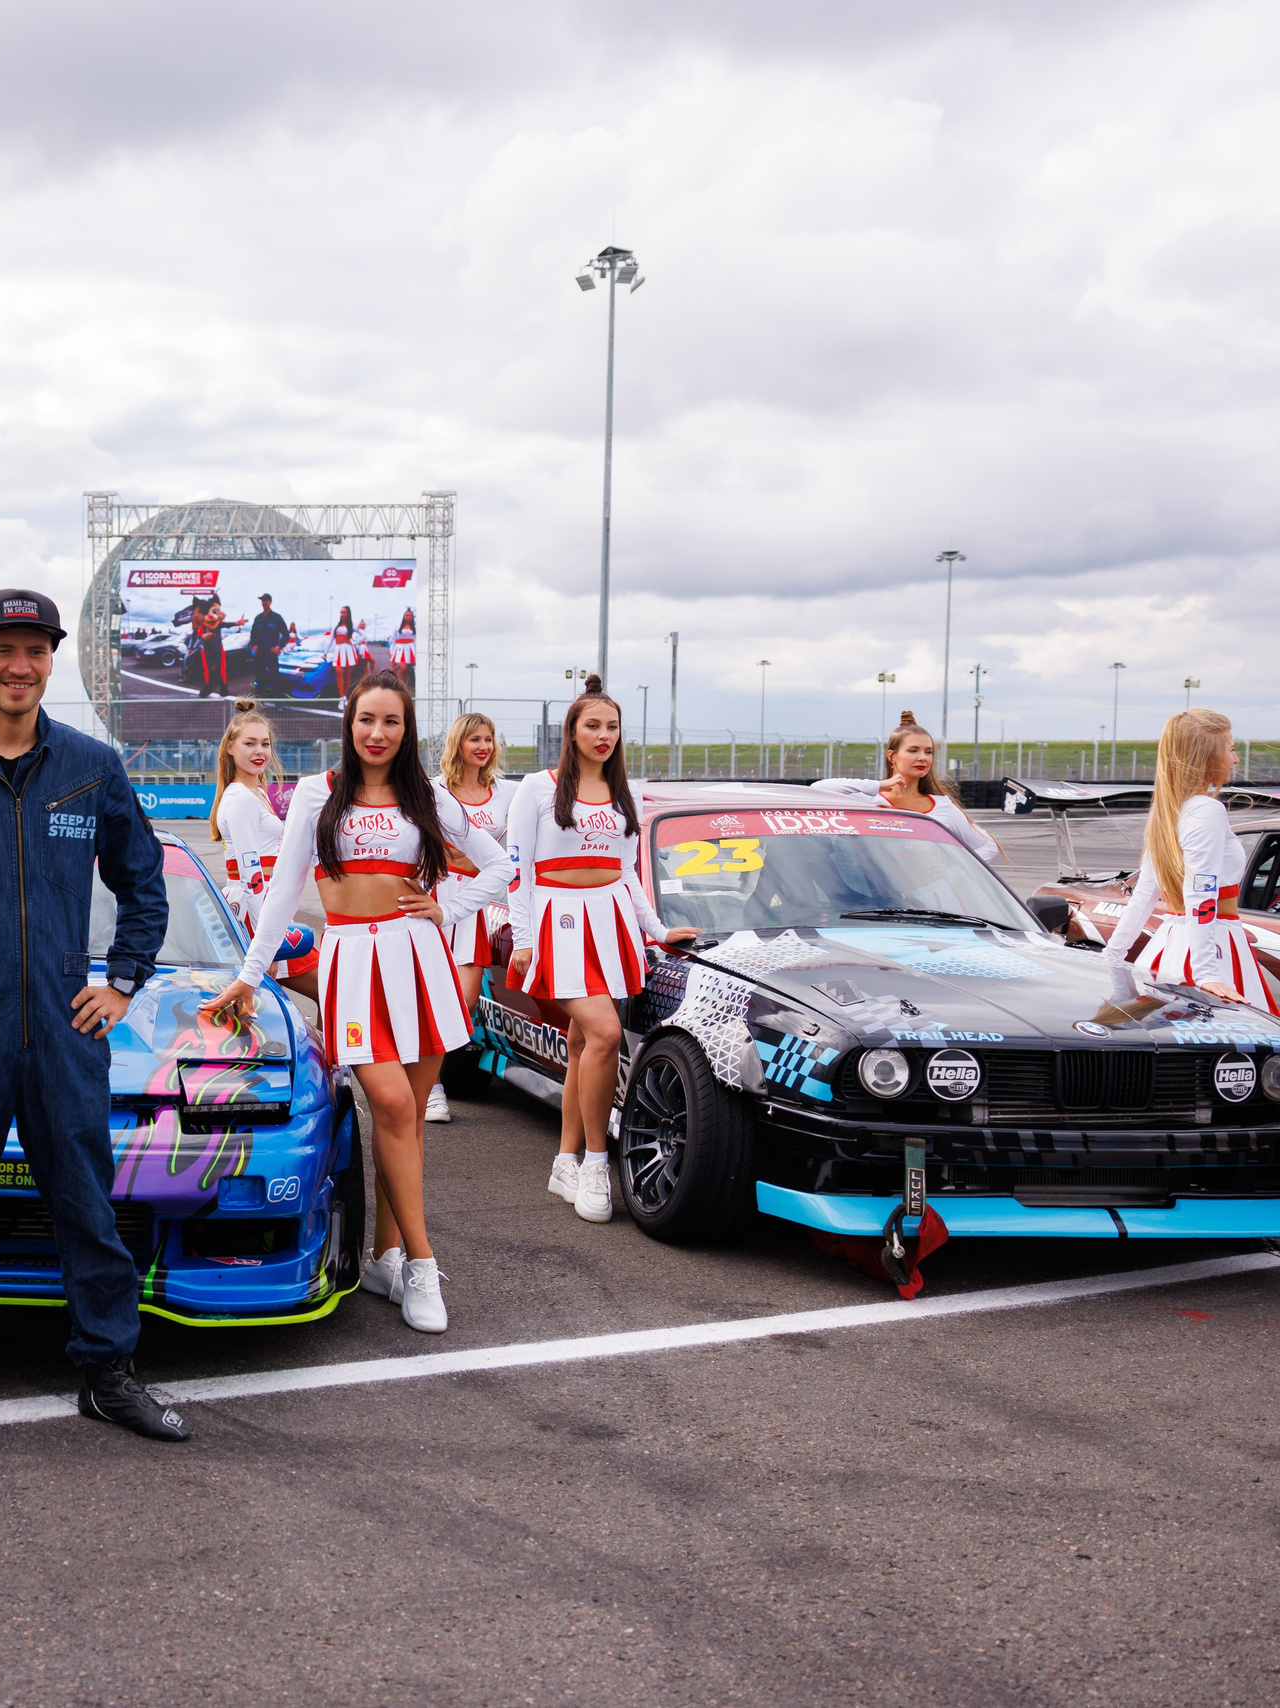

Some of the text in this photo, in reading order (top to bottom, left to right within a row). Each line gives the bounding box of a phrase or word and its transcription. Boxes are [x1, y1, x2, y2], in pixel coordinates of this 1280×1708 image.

[145, 572, 171, 580] IGORA
[172, 572, 196, 580] DRIVE
[3, 600, 38, 609] MAMA SAYS
[14, 606, 39, 615] SPECIAL
[49, 813, 97, 827] KEEP IT
[762, 816, 856, 830] IDDC
[48, 824, 96, 839] STREET
[353, 847, 389, 855] ДРАЙВ
[581, 843, 610, 851] ДРАЙВ
[672, 839, 765, 877] 23
[654, 967, 685, 980] STYLE
[1170, 1020, 1261, 1031] BOOST
[890, 1030, 1005, 1042] TRAILHEAD
[1171, 1030, 1280, 1046] MOTORS
[931, 1067, 977, 1080] Hella
[1218, 1069, 1253, 1082] Hella
[911, 1171, 921, 1209] LUKE
